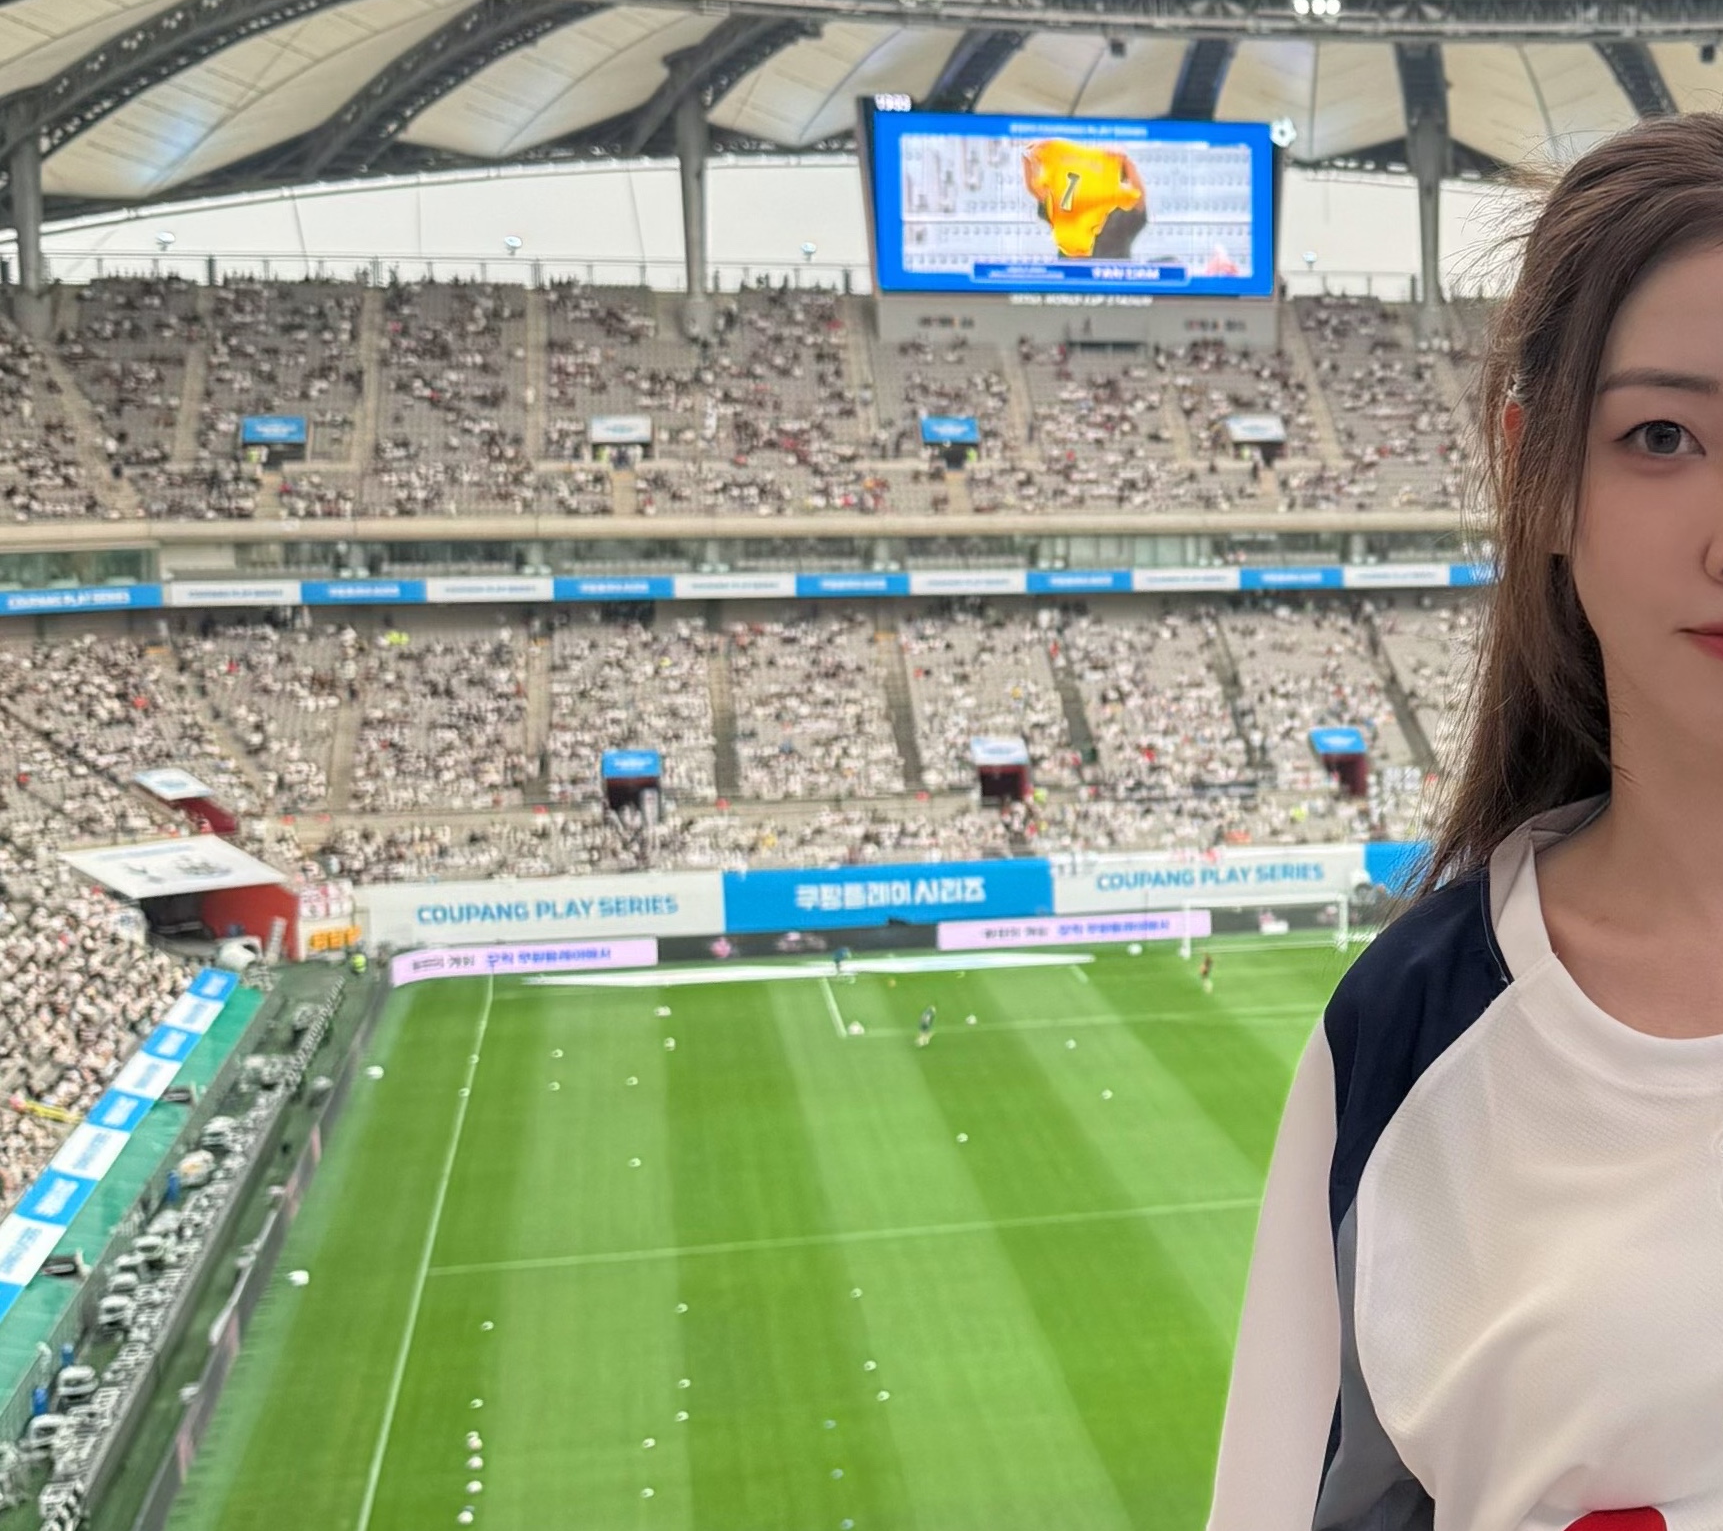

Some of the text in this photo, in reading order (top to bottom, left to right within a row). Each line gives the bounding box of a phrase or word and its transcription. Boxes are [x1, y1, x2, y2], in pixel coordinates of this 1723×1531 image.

[1095, 862, 1325, 892] COUPANG PLAY SERIES
[416, 894, 679, 925] COUPANG PLAY SERIES
